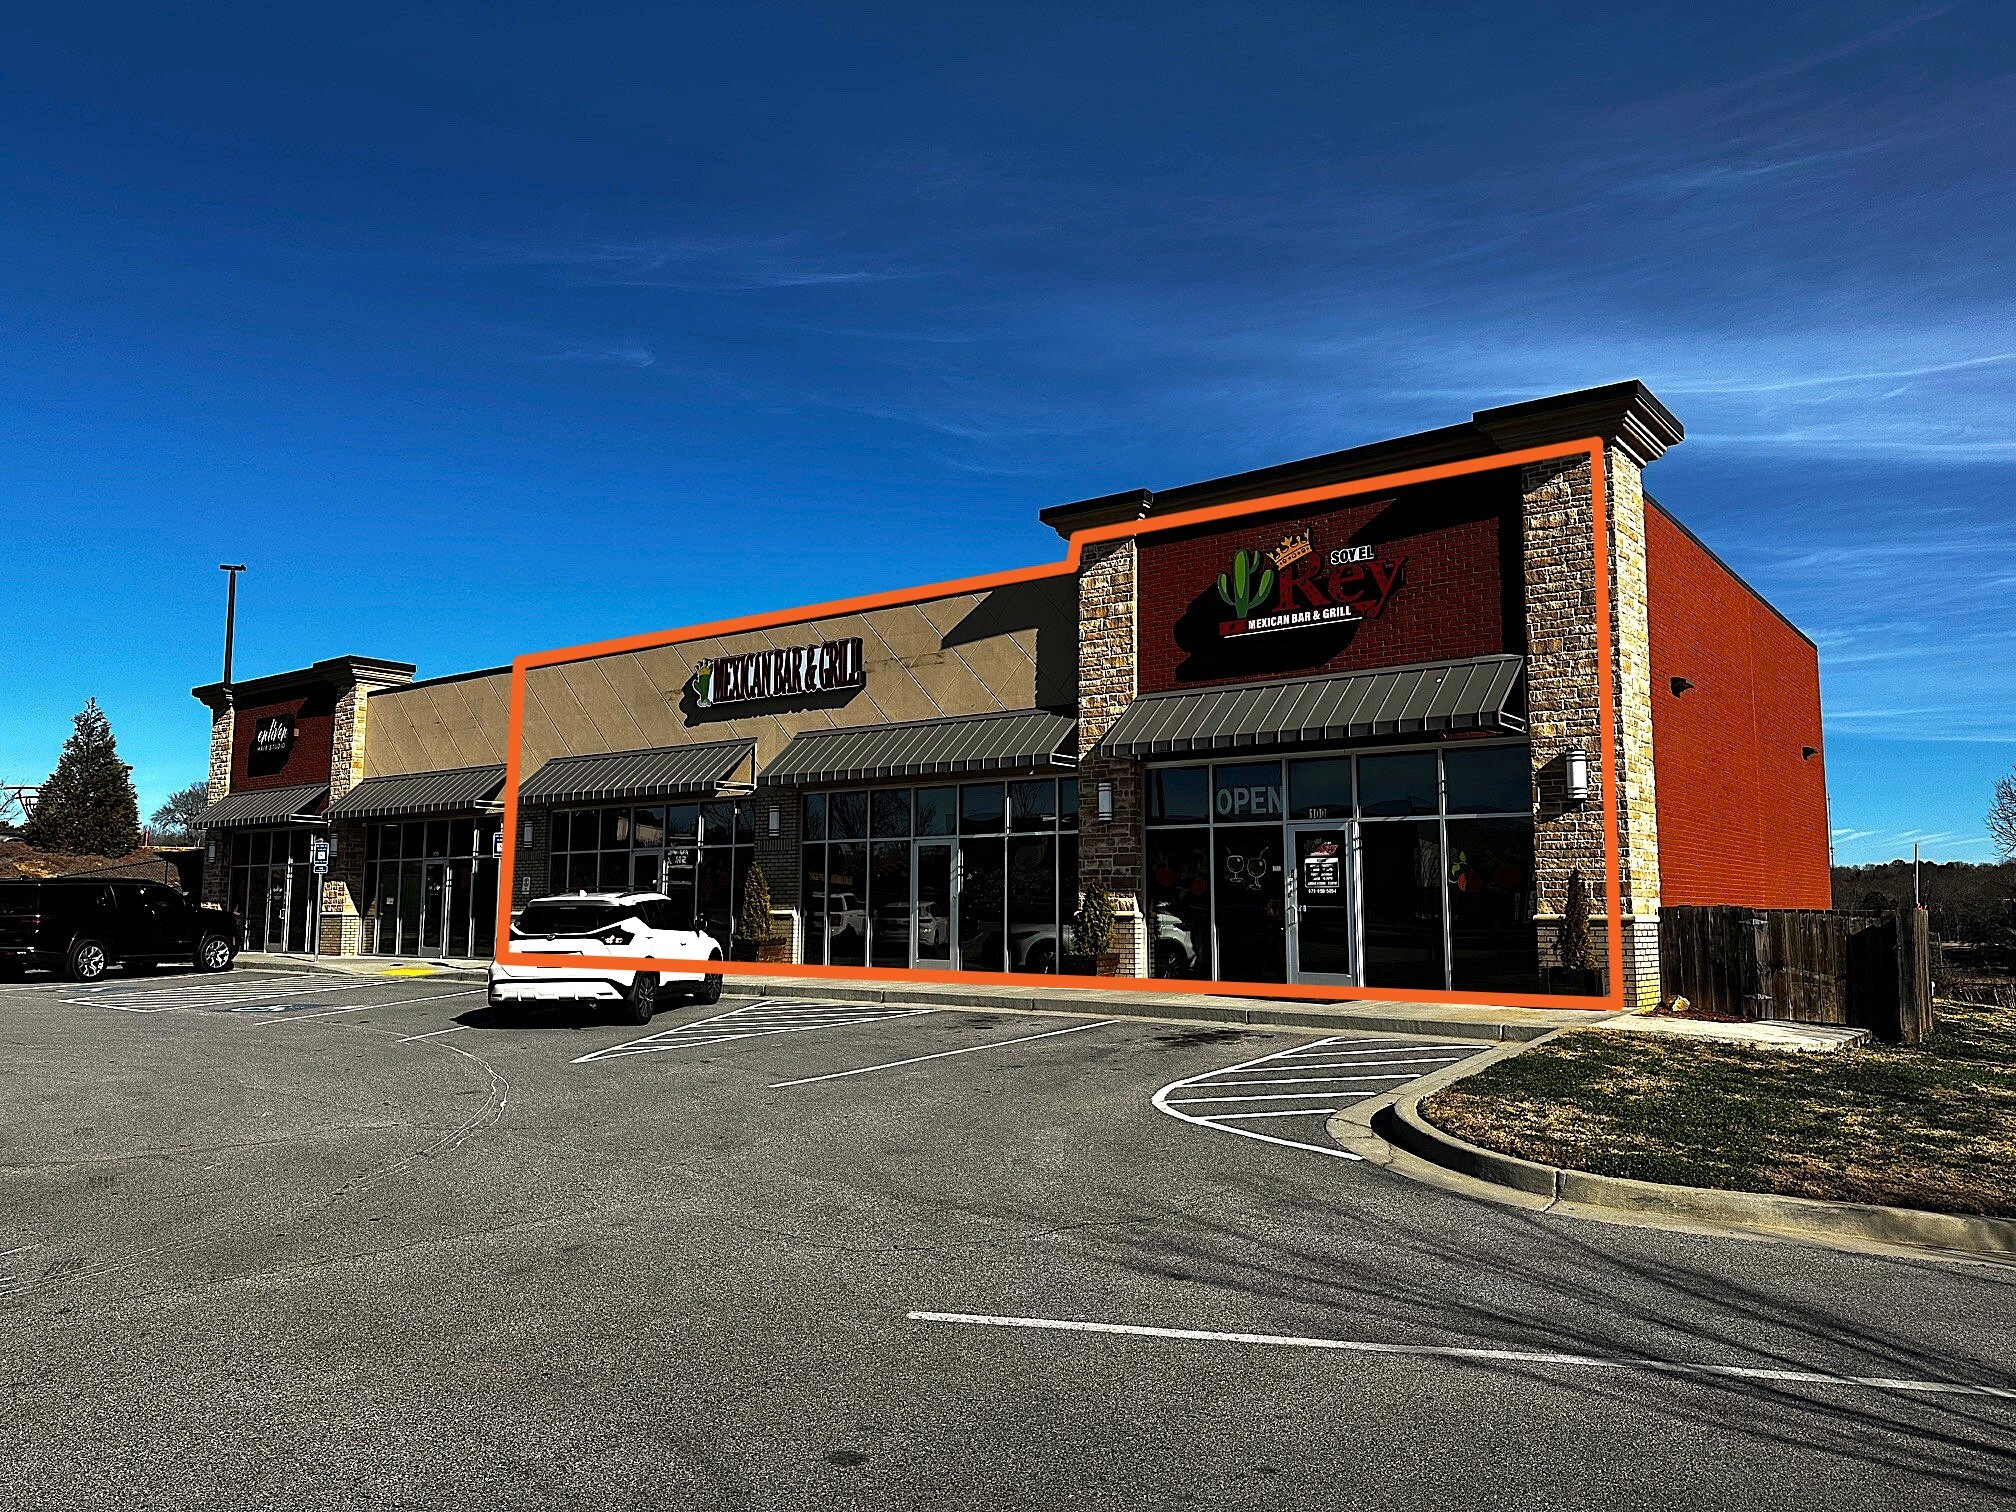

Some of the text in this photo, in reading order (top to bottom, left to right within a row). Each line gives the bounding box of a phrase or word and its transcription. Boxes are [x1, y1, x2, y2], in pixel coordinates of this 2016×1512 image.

[1331, 545, 1374, 565] SOY EL
[1272, 552, 1404, 618] Rey
[1248, 606, 1352, 630] MEXICAN BAR & GRILL
[713, 637, 864, 703] MEXICAN BAR & GRILL
[1217, 786, 1286, 815] OPEN
